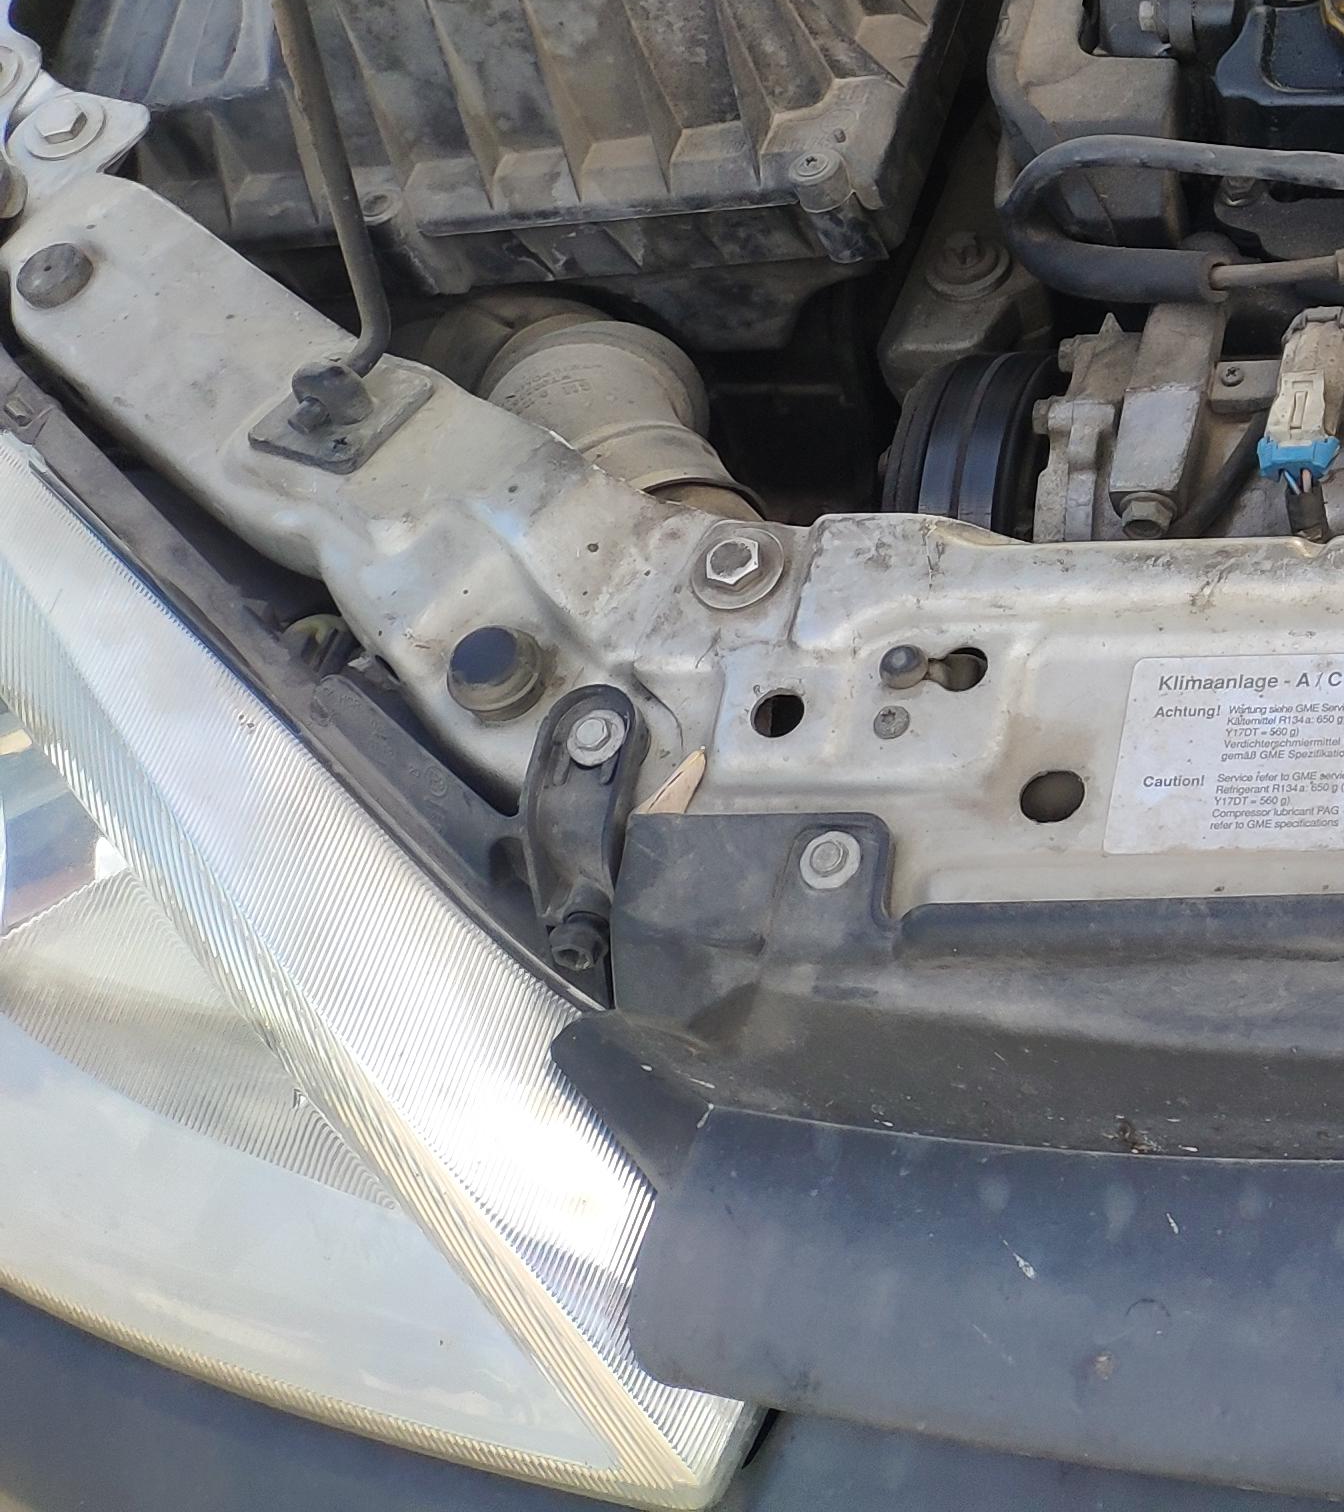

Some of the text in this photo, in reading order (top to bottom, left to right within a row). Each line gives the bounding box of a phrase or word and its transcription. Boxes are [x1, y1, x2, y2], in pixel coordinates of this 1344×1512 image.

[1158, 673, 1279, 693] Klimaanlage
[1295, 672, 1311, 688] A
[1327, 671, 1343, 688] C
[1153, 705, 1221, 720] Achtung!
[1295, 704, 1320, 713] GME
[1316, 714, 1334, 725] 650
[1268, 727, 1288, 737] 560
[1259, 749, 1286, 760] GME
[1142, 774, 1206, 788] Caution!
[1217, 773, 1254, 783] Service
[1280, 772, 1290, 782] to
[1291, 771, 1318, 781] GME
[1215, 784, 1271, 796] Refrigerant
[1310, 782, 1330, 793] 650
[1214, 796, 1249, 807] Y17DT
[1258, 796, 1279, 806] 560
[1211, 808, 1273, 821] Compressor
[1273, 807, 1315, 818] lubricant
[1316, 807, 1340, 817] PAG
[1209, 821, 1234, 831] refer
[1234, 821, 1245, 830] to
[1246, 819, 1273, 830] GME
